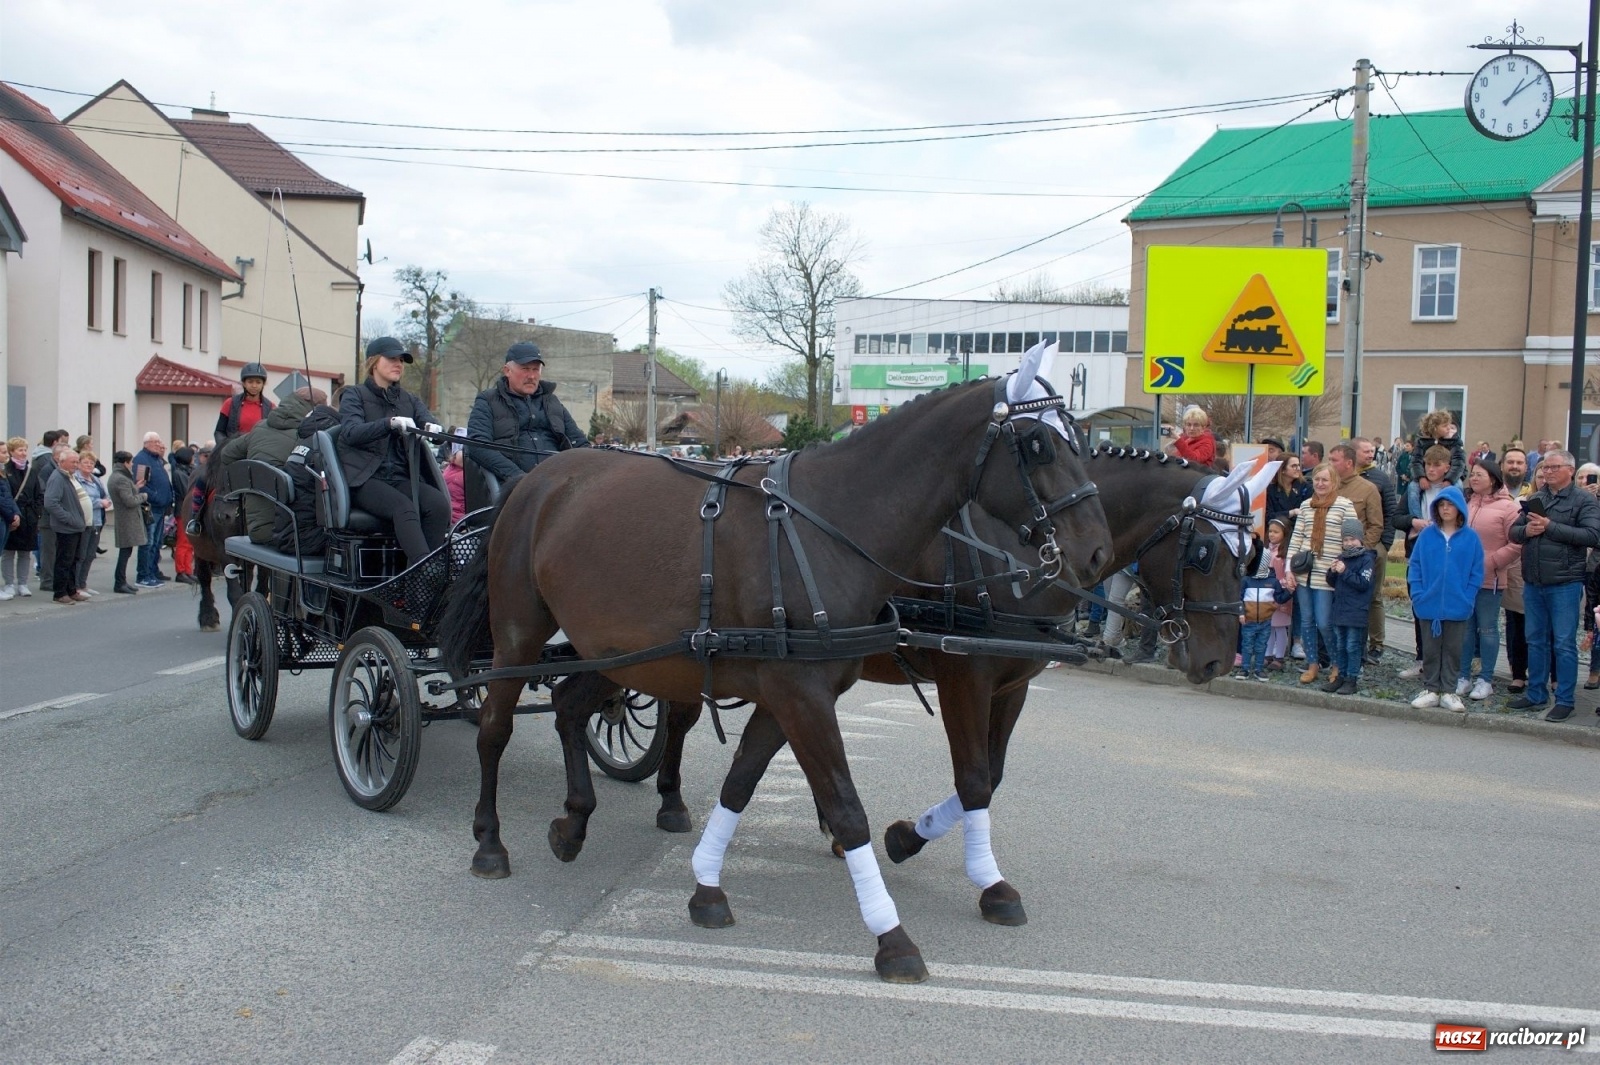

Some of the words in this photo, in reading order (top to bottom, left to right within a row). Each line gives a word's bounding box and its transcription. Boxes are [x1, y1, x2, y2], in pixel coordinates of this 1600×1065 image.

[1493, 66, 1499, 75] 11
[1507, 62, 1516, 72] 12
[1526, 66, 1528, 74] 1
[1480, 77, 1488, 87] 10
[1474, 93, 1480, 102] 9
[1542, 93, 1547, 102] 3
[1480, 109, 1485, 118] 8
[1536, 109, 1540, 118] 4
[1492, 119, 1496, 128] 7
[1507, 123, 1512, 132] 6
[1523, 120, 1528, 129] 5
